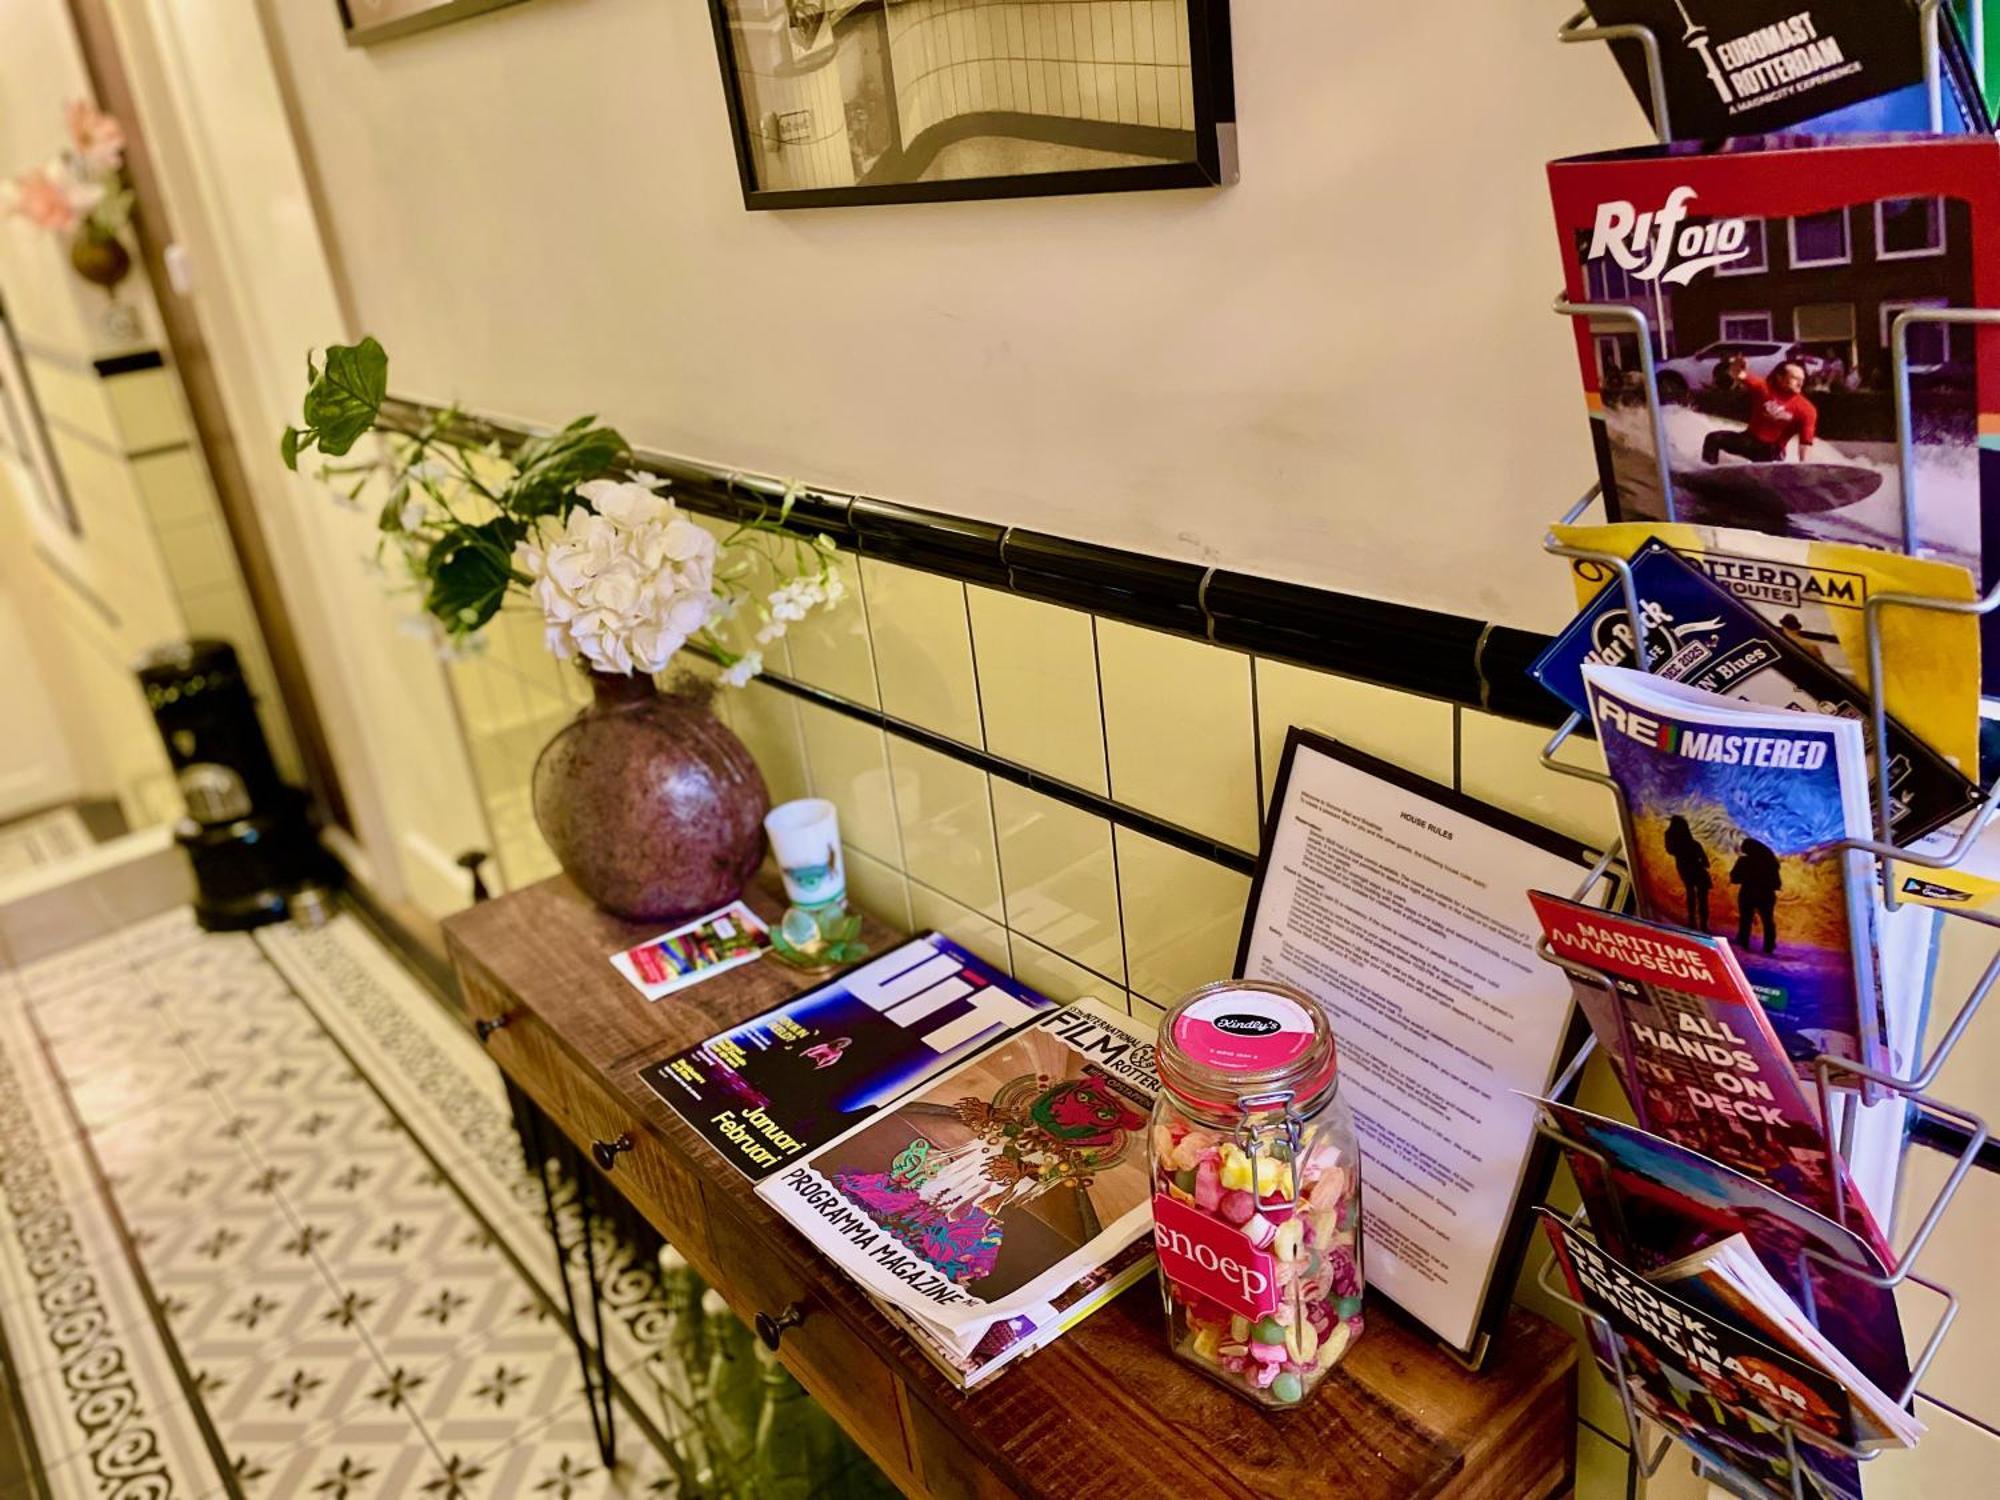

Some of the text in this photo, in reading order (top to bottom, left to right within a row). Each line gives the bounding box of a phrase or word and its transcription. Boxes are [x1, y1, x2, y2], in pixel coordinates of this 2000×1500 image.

[1716, 10, 1817, 71] EUROMAST
[1729, 35, 1845, 98] ROTTERDAM
[1678, 645, 1705, 666] 2025
[1716, 646, 1766, 679] Blues
[1599, 695, 1827, 770] RE MASTERED
[1400, 812, 1453, 840] HOUSE RULES
[1577, 922, 1706, 967] MARITIME
[1040, 1010, 1130, 1065] FILM
[1083, 1013, 1141, 1048] INTERNATIONAL
[1630, 1021, 1760, 1072] HANDS
[1678, 1012, 1746, 1045] ALL
[1686, 1085, 1791, 1128] DECK
[1713, 1072, 1775, 1101] ON
[710, 1110, 783, 1169] Februari
[741, 1106, 807, 1155] Januari
[781, 1167, 879, 1251] PROGRAMMA
[869, 1243, 964, 1305] MAGAZINE
[1562, 1231, 1606, 1272] DE
[1155, 1221, 1268, 1305] snoep
[1569, 1250, 1808, 1410] TOCHT NAAR
[1579, 1269, 1722, 1380] ENERGIE
